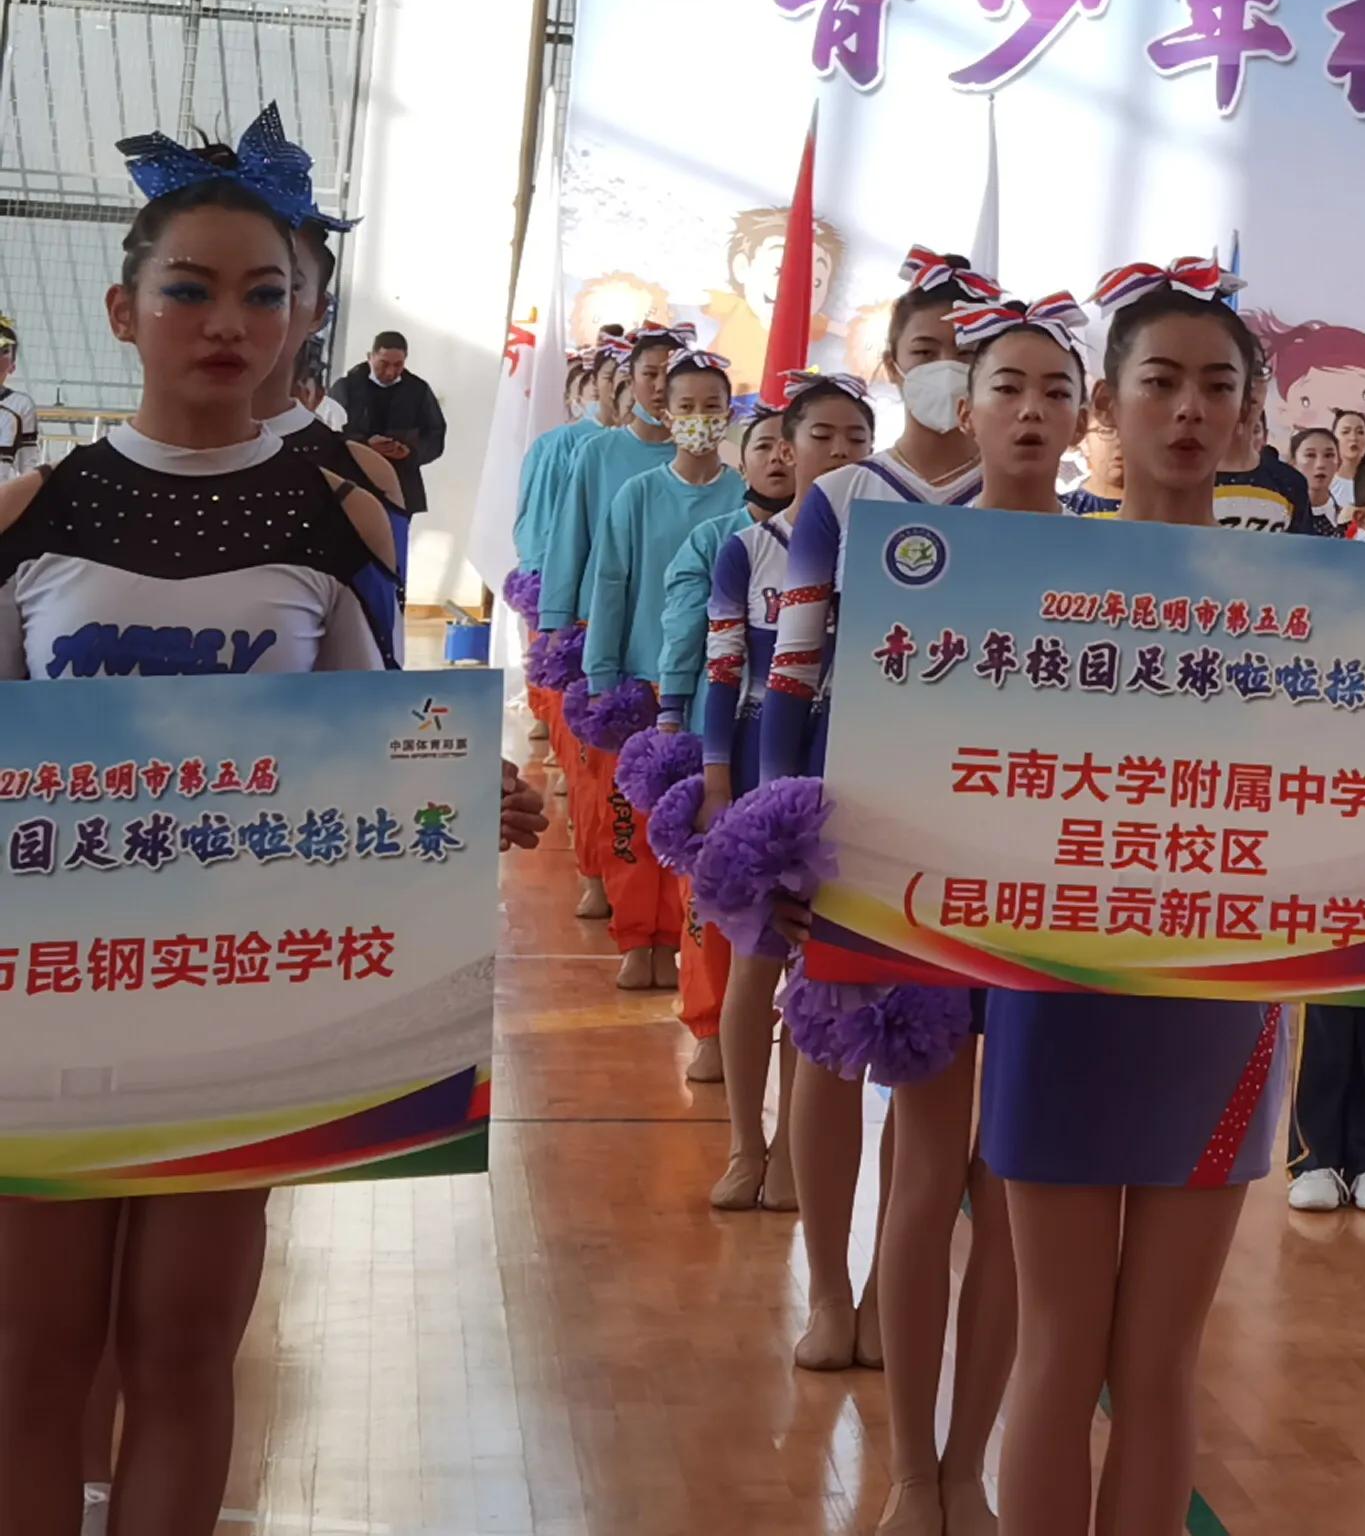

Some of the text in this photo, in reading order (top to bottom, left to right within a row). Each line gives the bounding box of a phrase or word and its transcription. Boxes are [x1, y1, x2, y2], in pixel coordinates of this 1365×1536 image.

[1041, 590, 1312, 640] 2021年昆明市第五届
[1054, 818, 1269, 876] 呈贡校区
